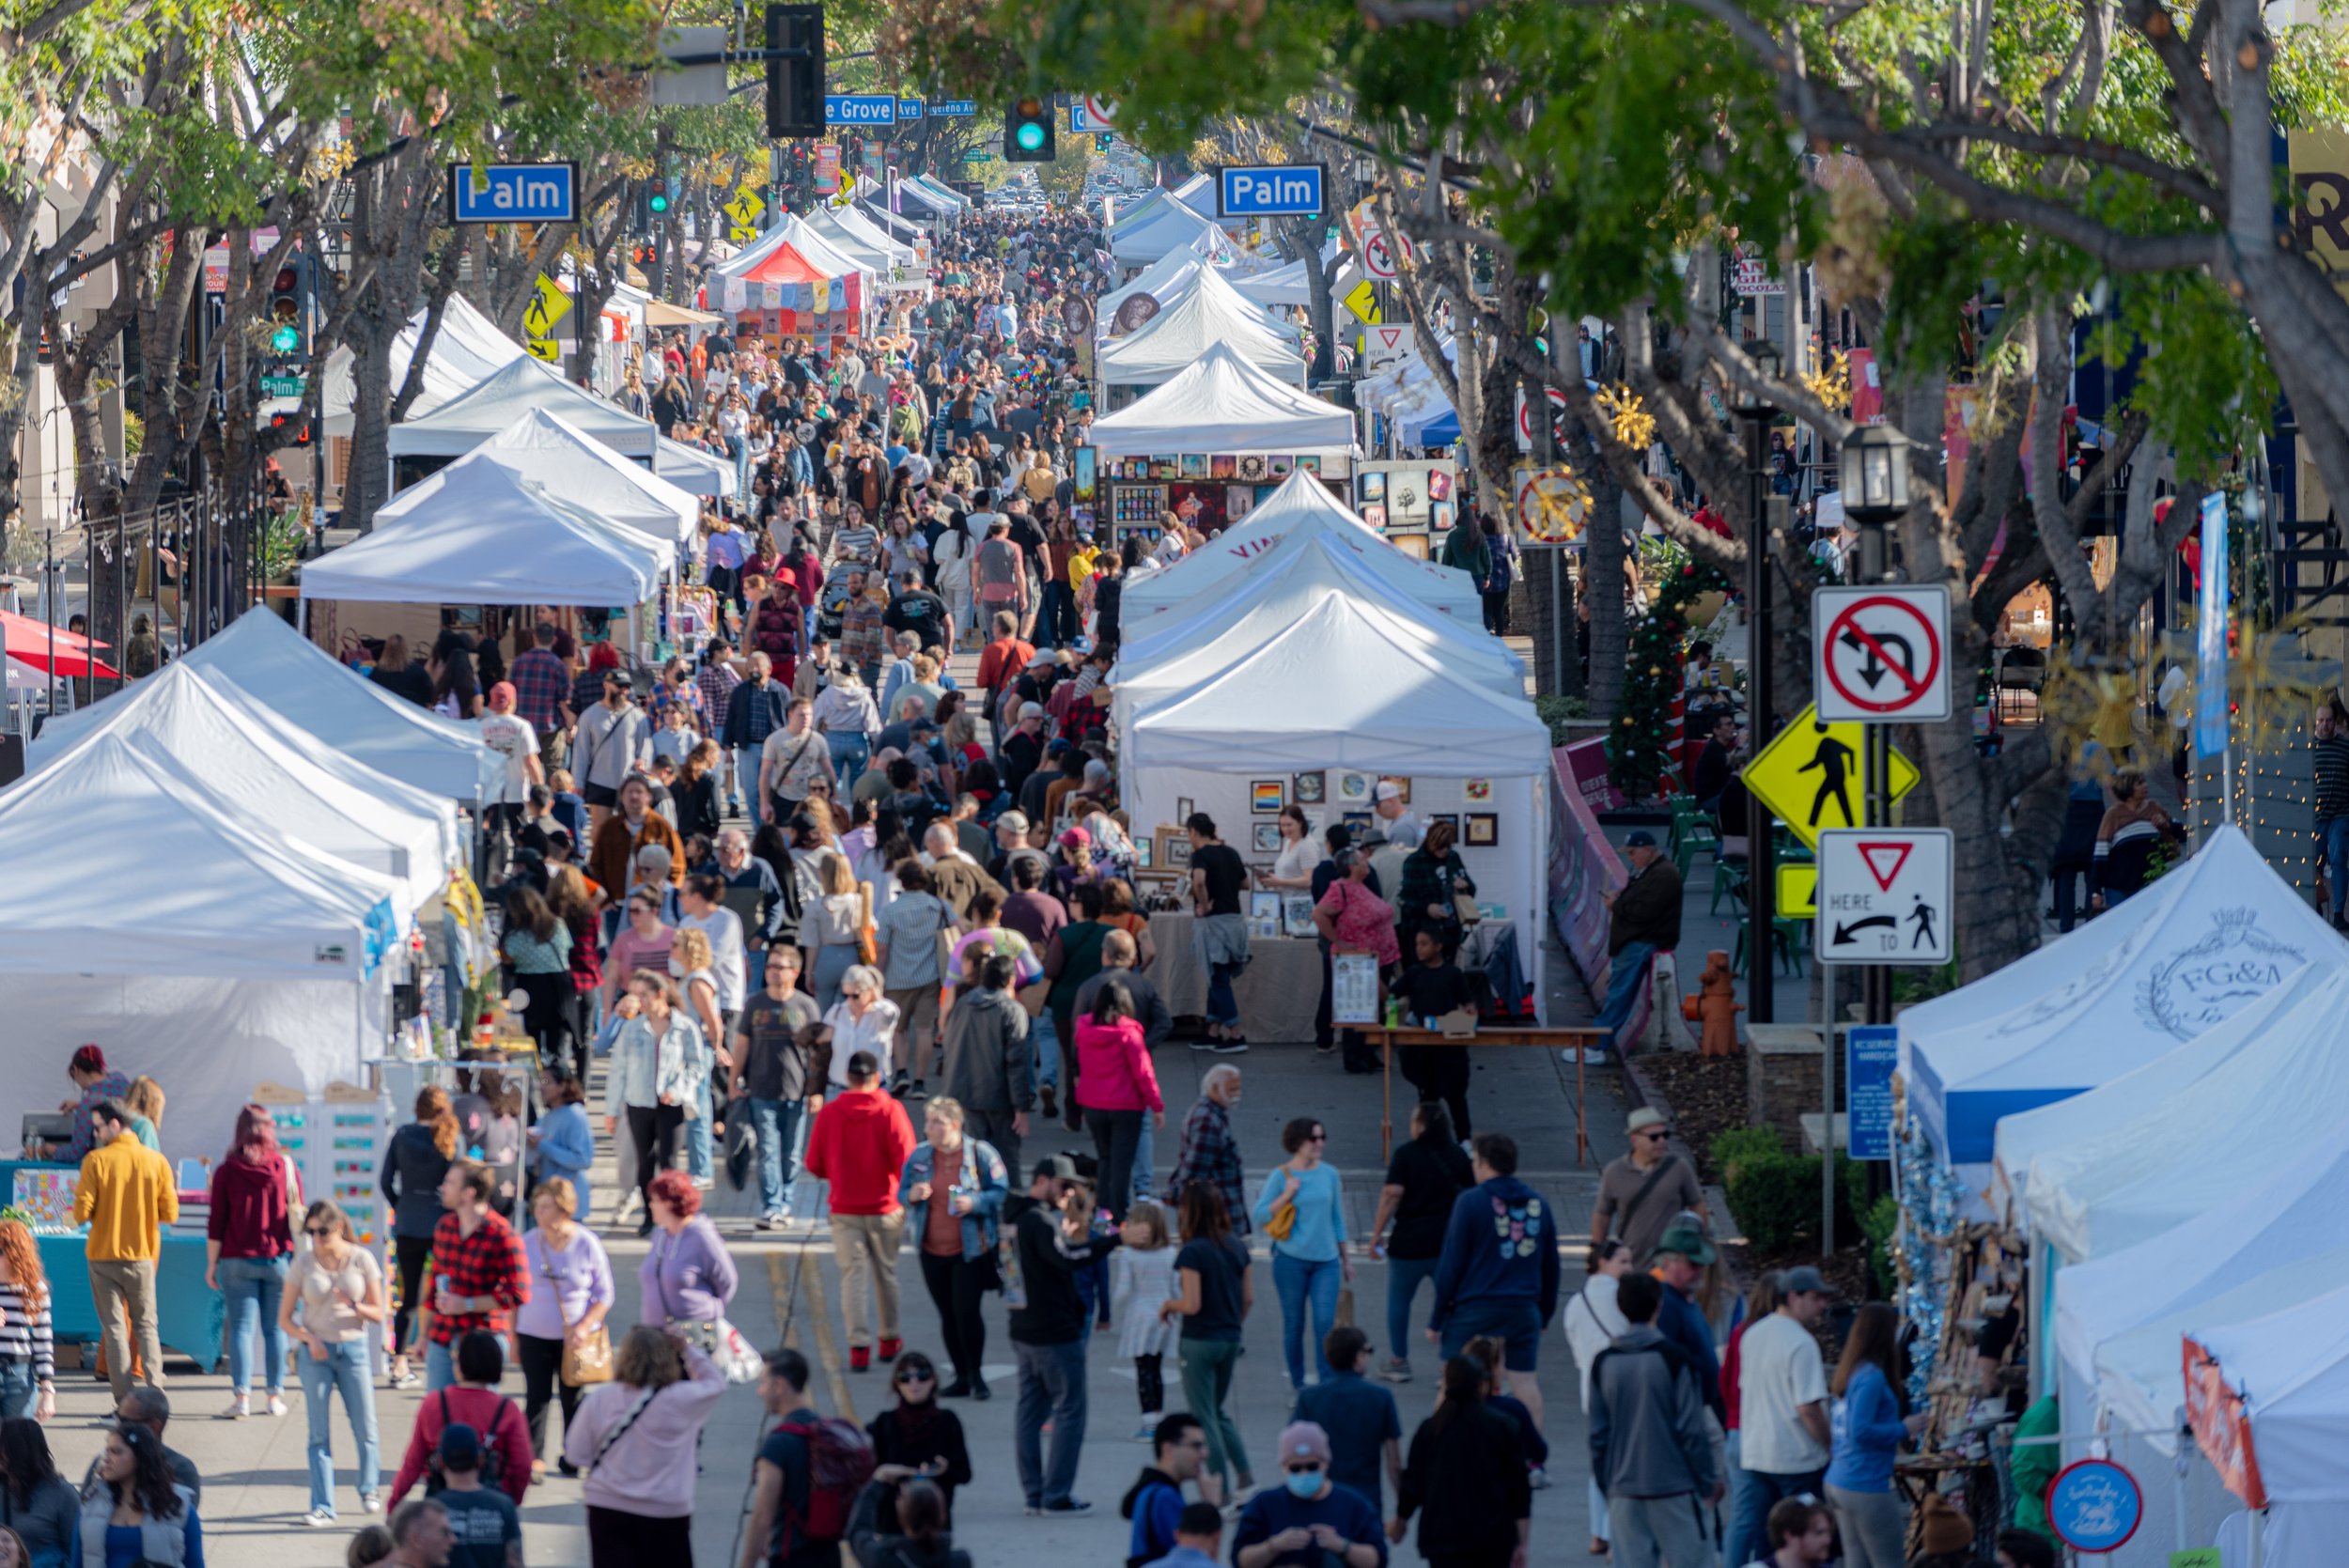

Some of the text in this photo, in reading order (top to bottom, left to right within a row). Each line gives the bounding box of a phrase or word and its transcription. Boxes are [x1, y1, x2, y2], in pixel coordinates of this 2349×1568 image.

[841, 101, 890, 118] Grove
[899, 103, 917, 116] Ave
[468, 175, 560, 209] Palm
[1234, 176, 1311, 204] Palm
[648, 246, 656, 262] 5
[1368, 349, 1386, 357] HERE
[261, 380, 294, 396] Palm
[1829, 894, 1874, 911] HERE
[1879, 934, 1899, 952] TO
